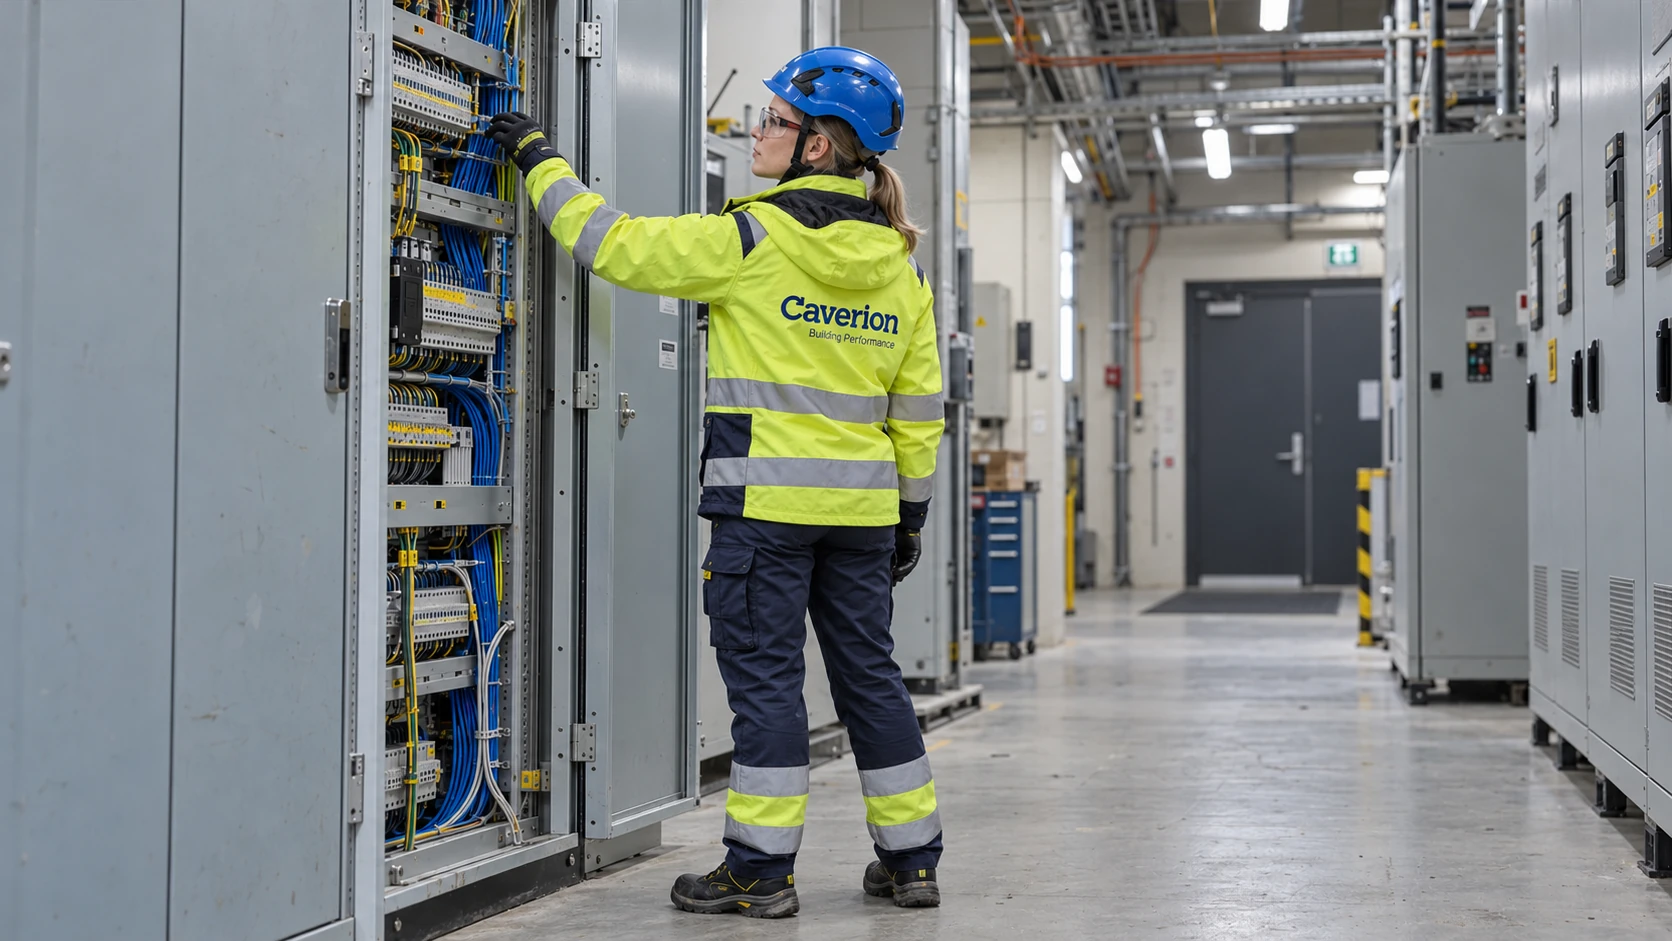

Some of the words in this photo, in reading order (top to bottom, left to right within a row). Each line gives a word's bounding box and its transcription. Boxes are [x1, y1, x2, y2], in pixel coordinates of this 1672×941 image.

[781, 295, 899, 335] Caverion
[809, 328, 842, 343] Building
[843, 333, 895, 349] Performance
